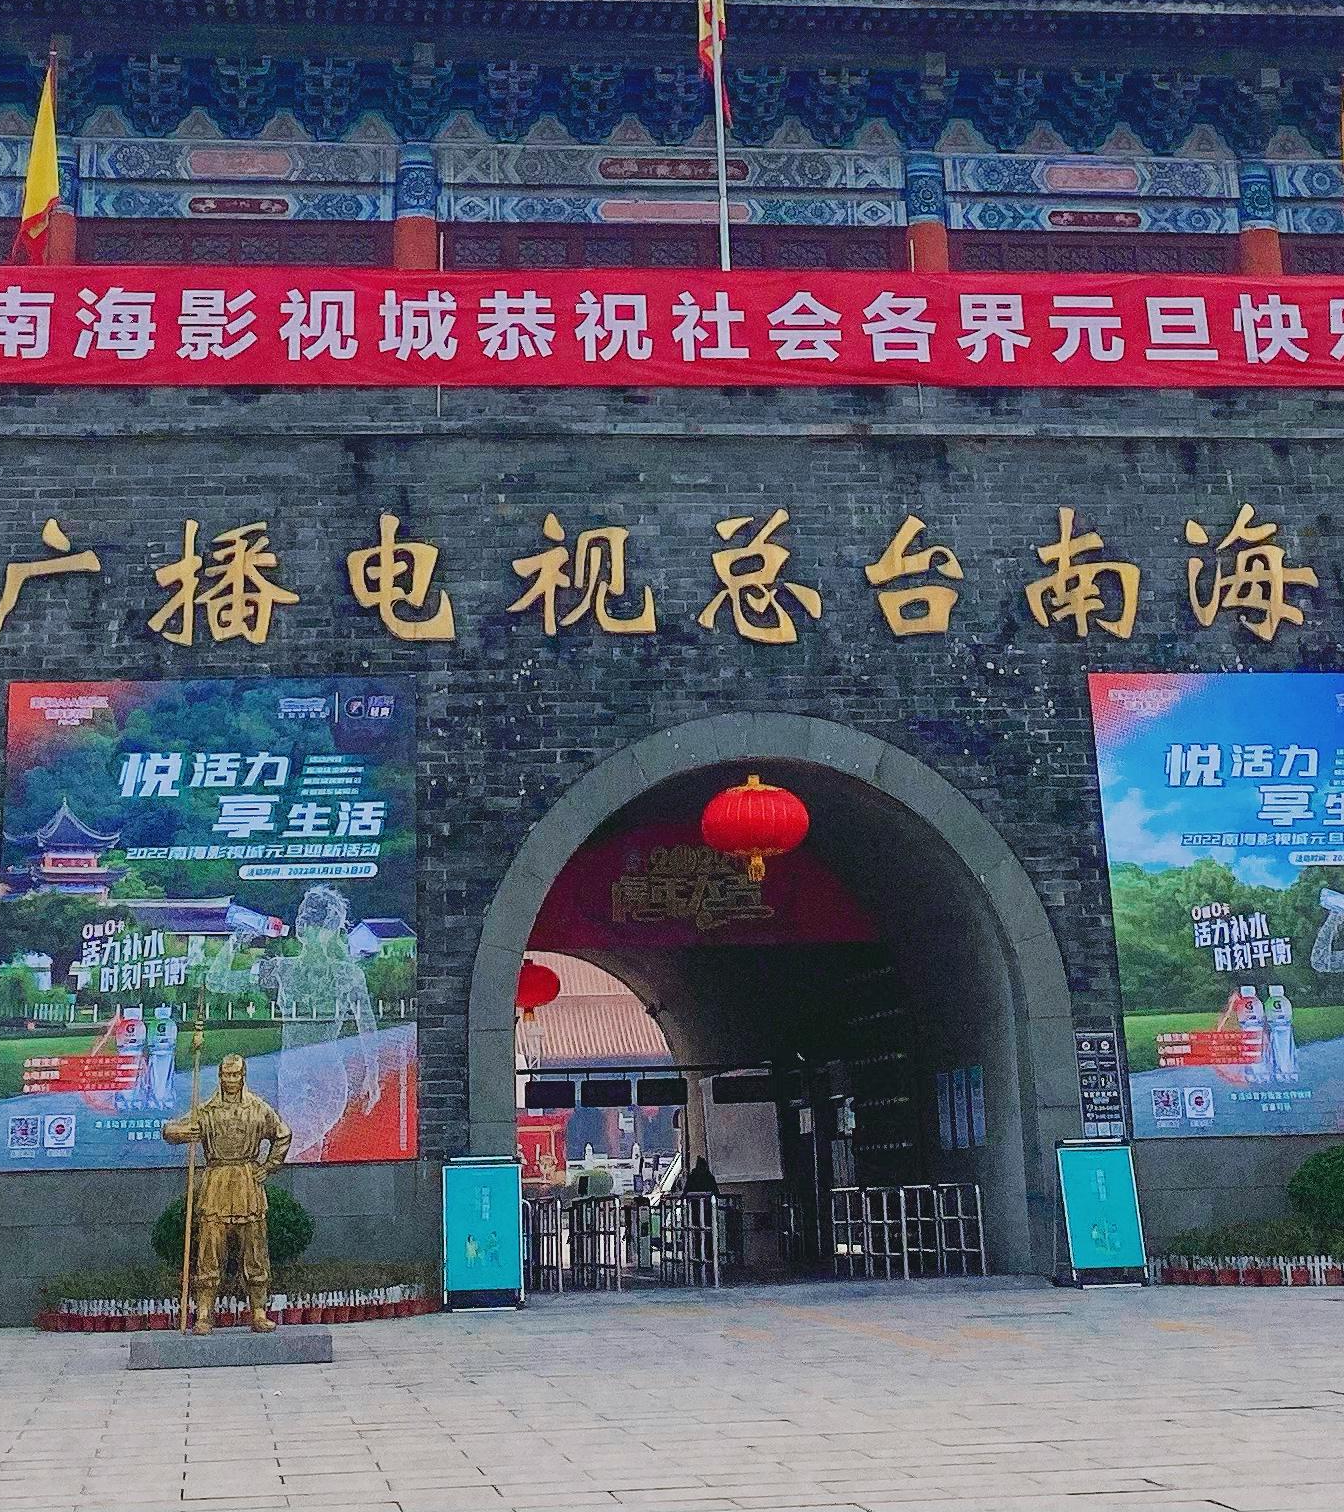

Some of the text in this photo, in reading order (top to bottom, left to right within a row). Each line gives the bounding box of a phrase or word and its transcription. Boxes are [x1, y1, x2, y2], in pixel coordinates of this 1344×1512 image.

[119, 752, 290, 797] 悦活力
[1165, 744, 1319, 786] 悦活力
[212, 794, 385, 838] 享生活
[126, 843, 380, 861] 2022南海影视城元旦迎新活动
[1194, 912, 1270, 948] 活力补水
[82, 930, 165, 967] 活力补水
[1214, 937, 1292, 972] 时刻平衡
[100, 957, 187, 993] 时刻平衡
